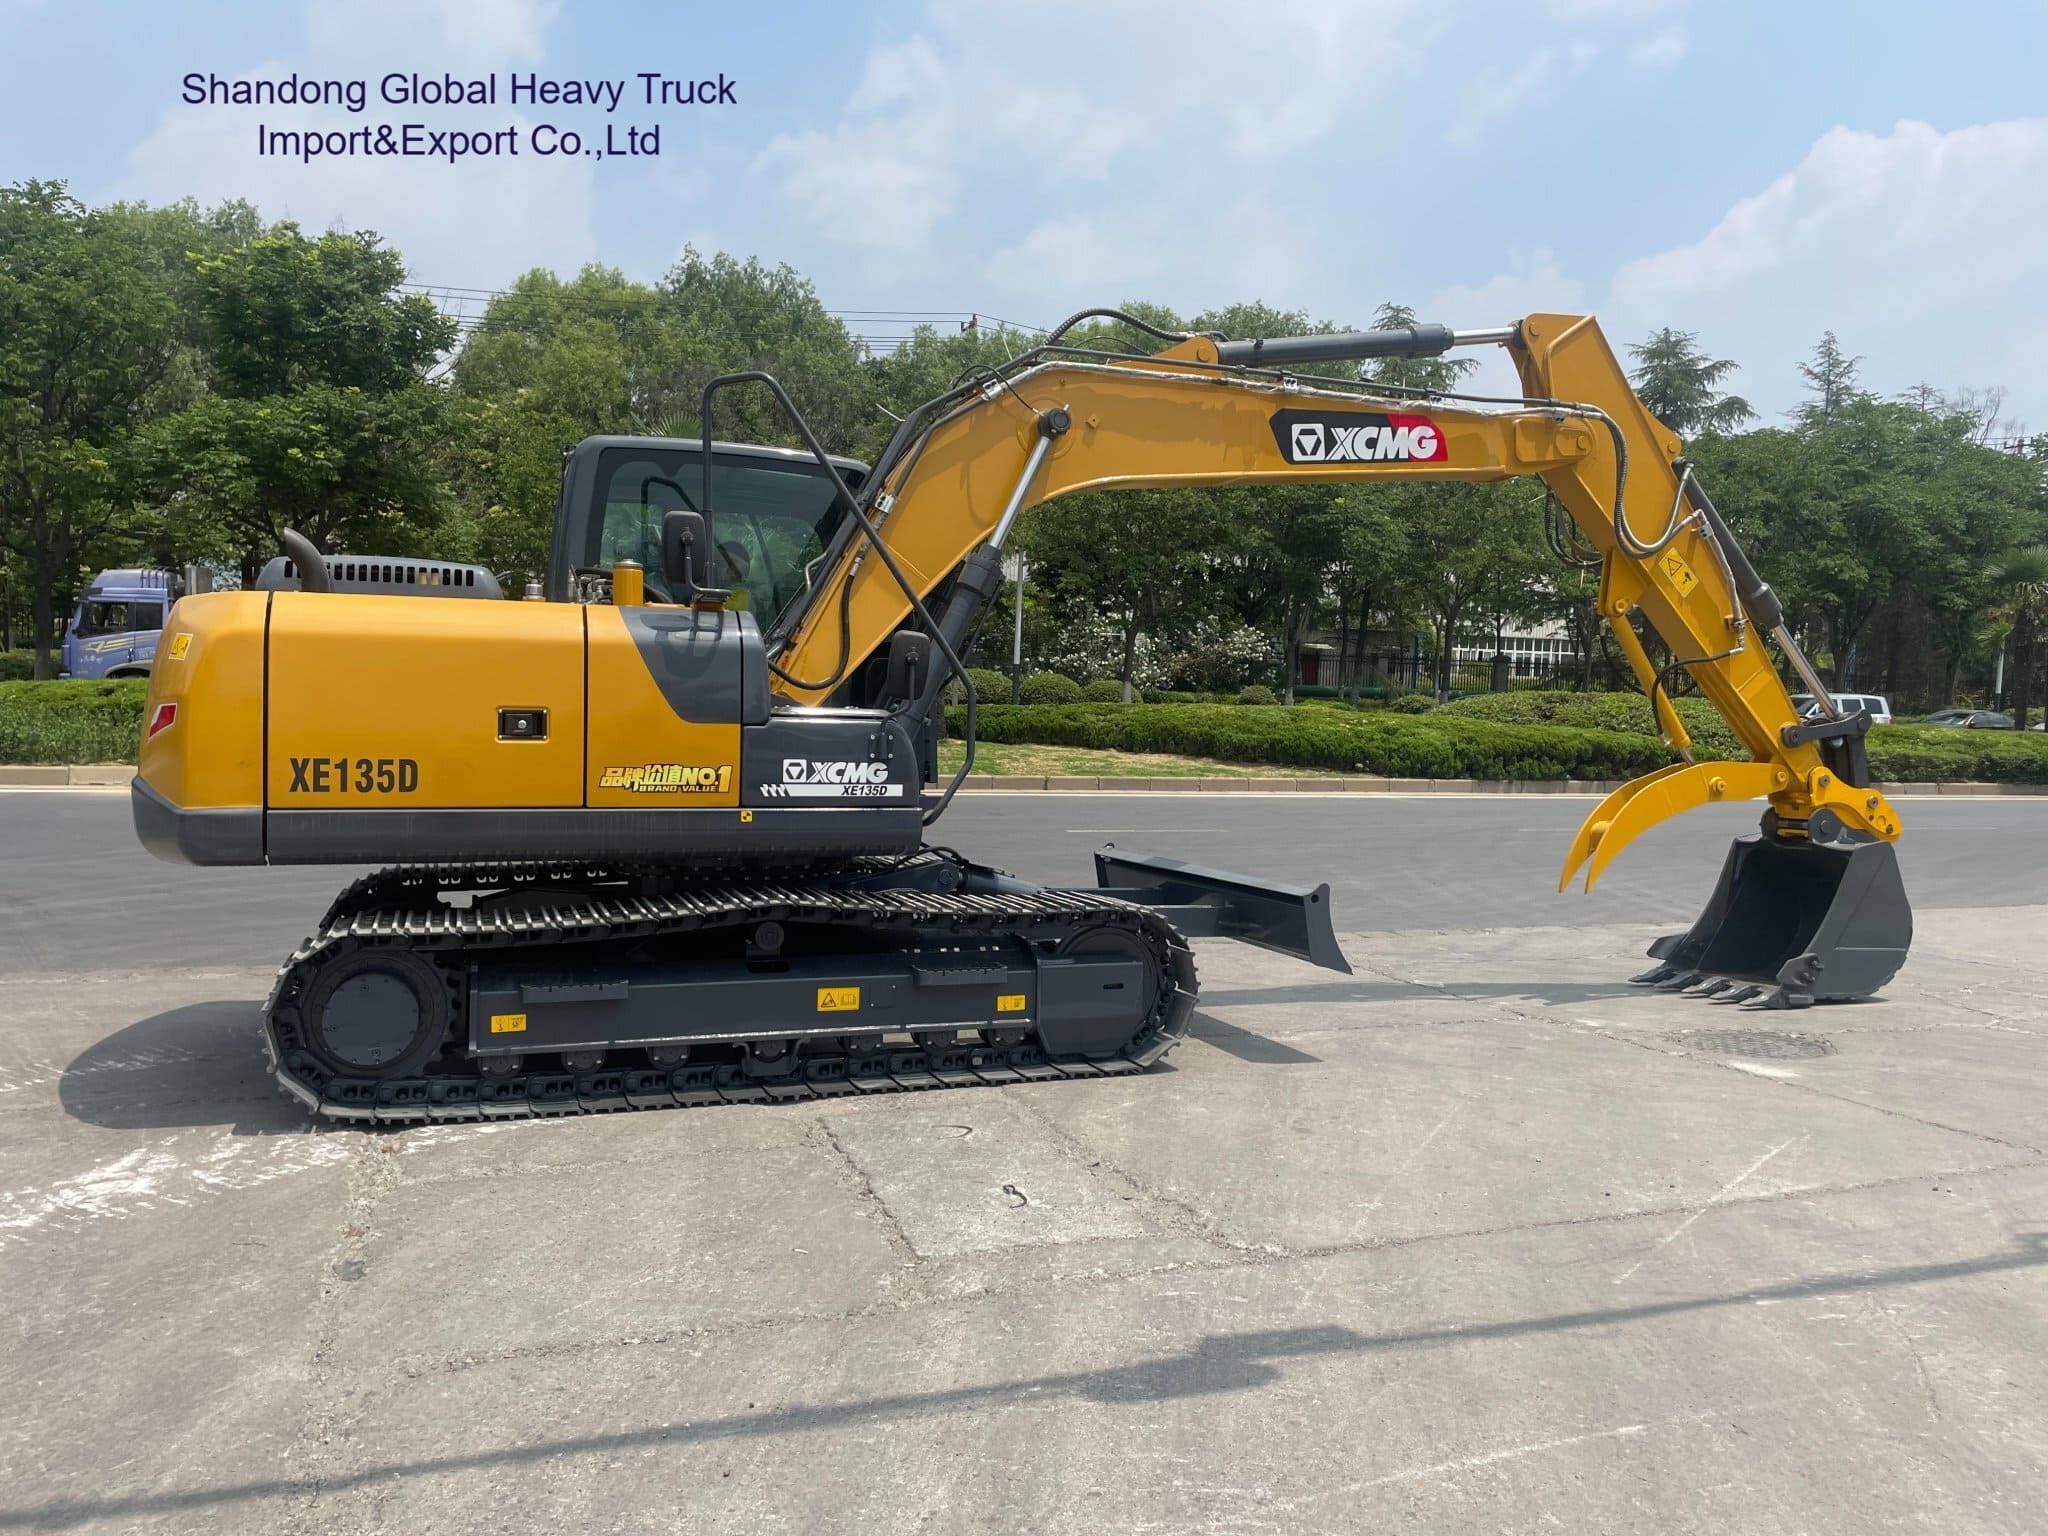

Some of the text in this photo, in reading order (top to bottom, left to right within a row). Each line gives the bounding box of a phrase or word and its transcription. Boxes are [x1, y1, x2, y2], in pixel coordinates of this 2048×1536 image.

[1325, 425, 1438, 461] XCMG
[289, 758, 418, 793] XE135D
[806, 762, 889, 784] XCMG
[640, 784, 717, 793] BRAND VALUE
[841, 785, 888, 796] XE135D
